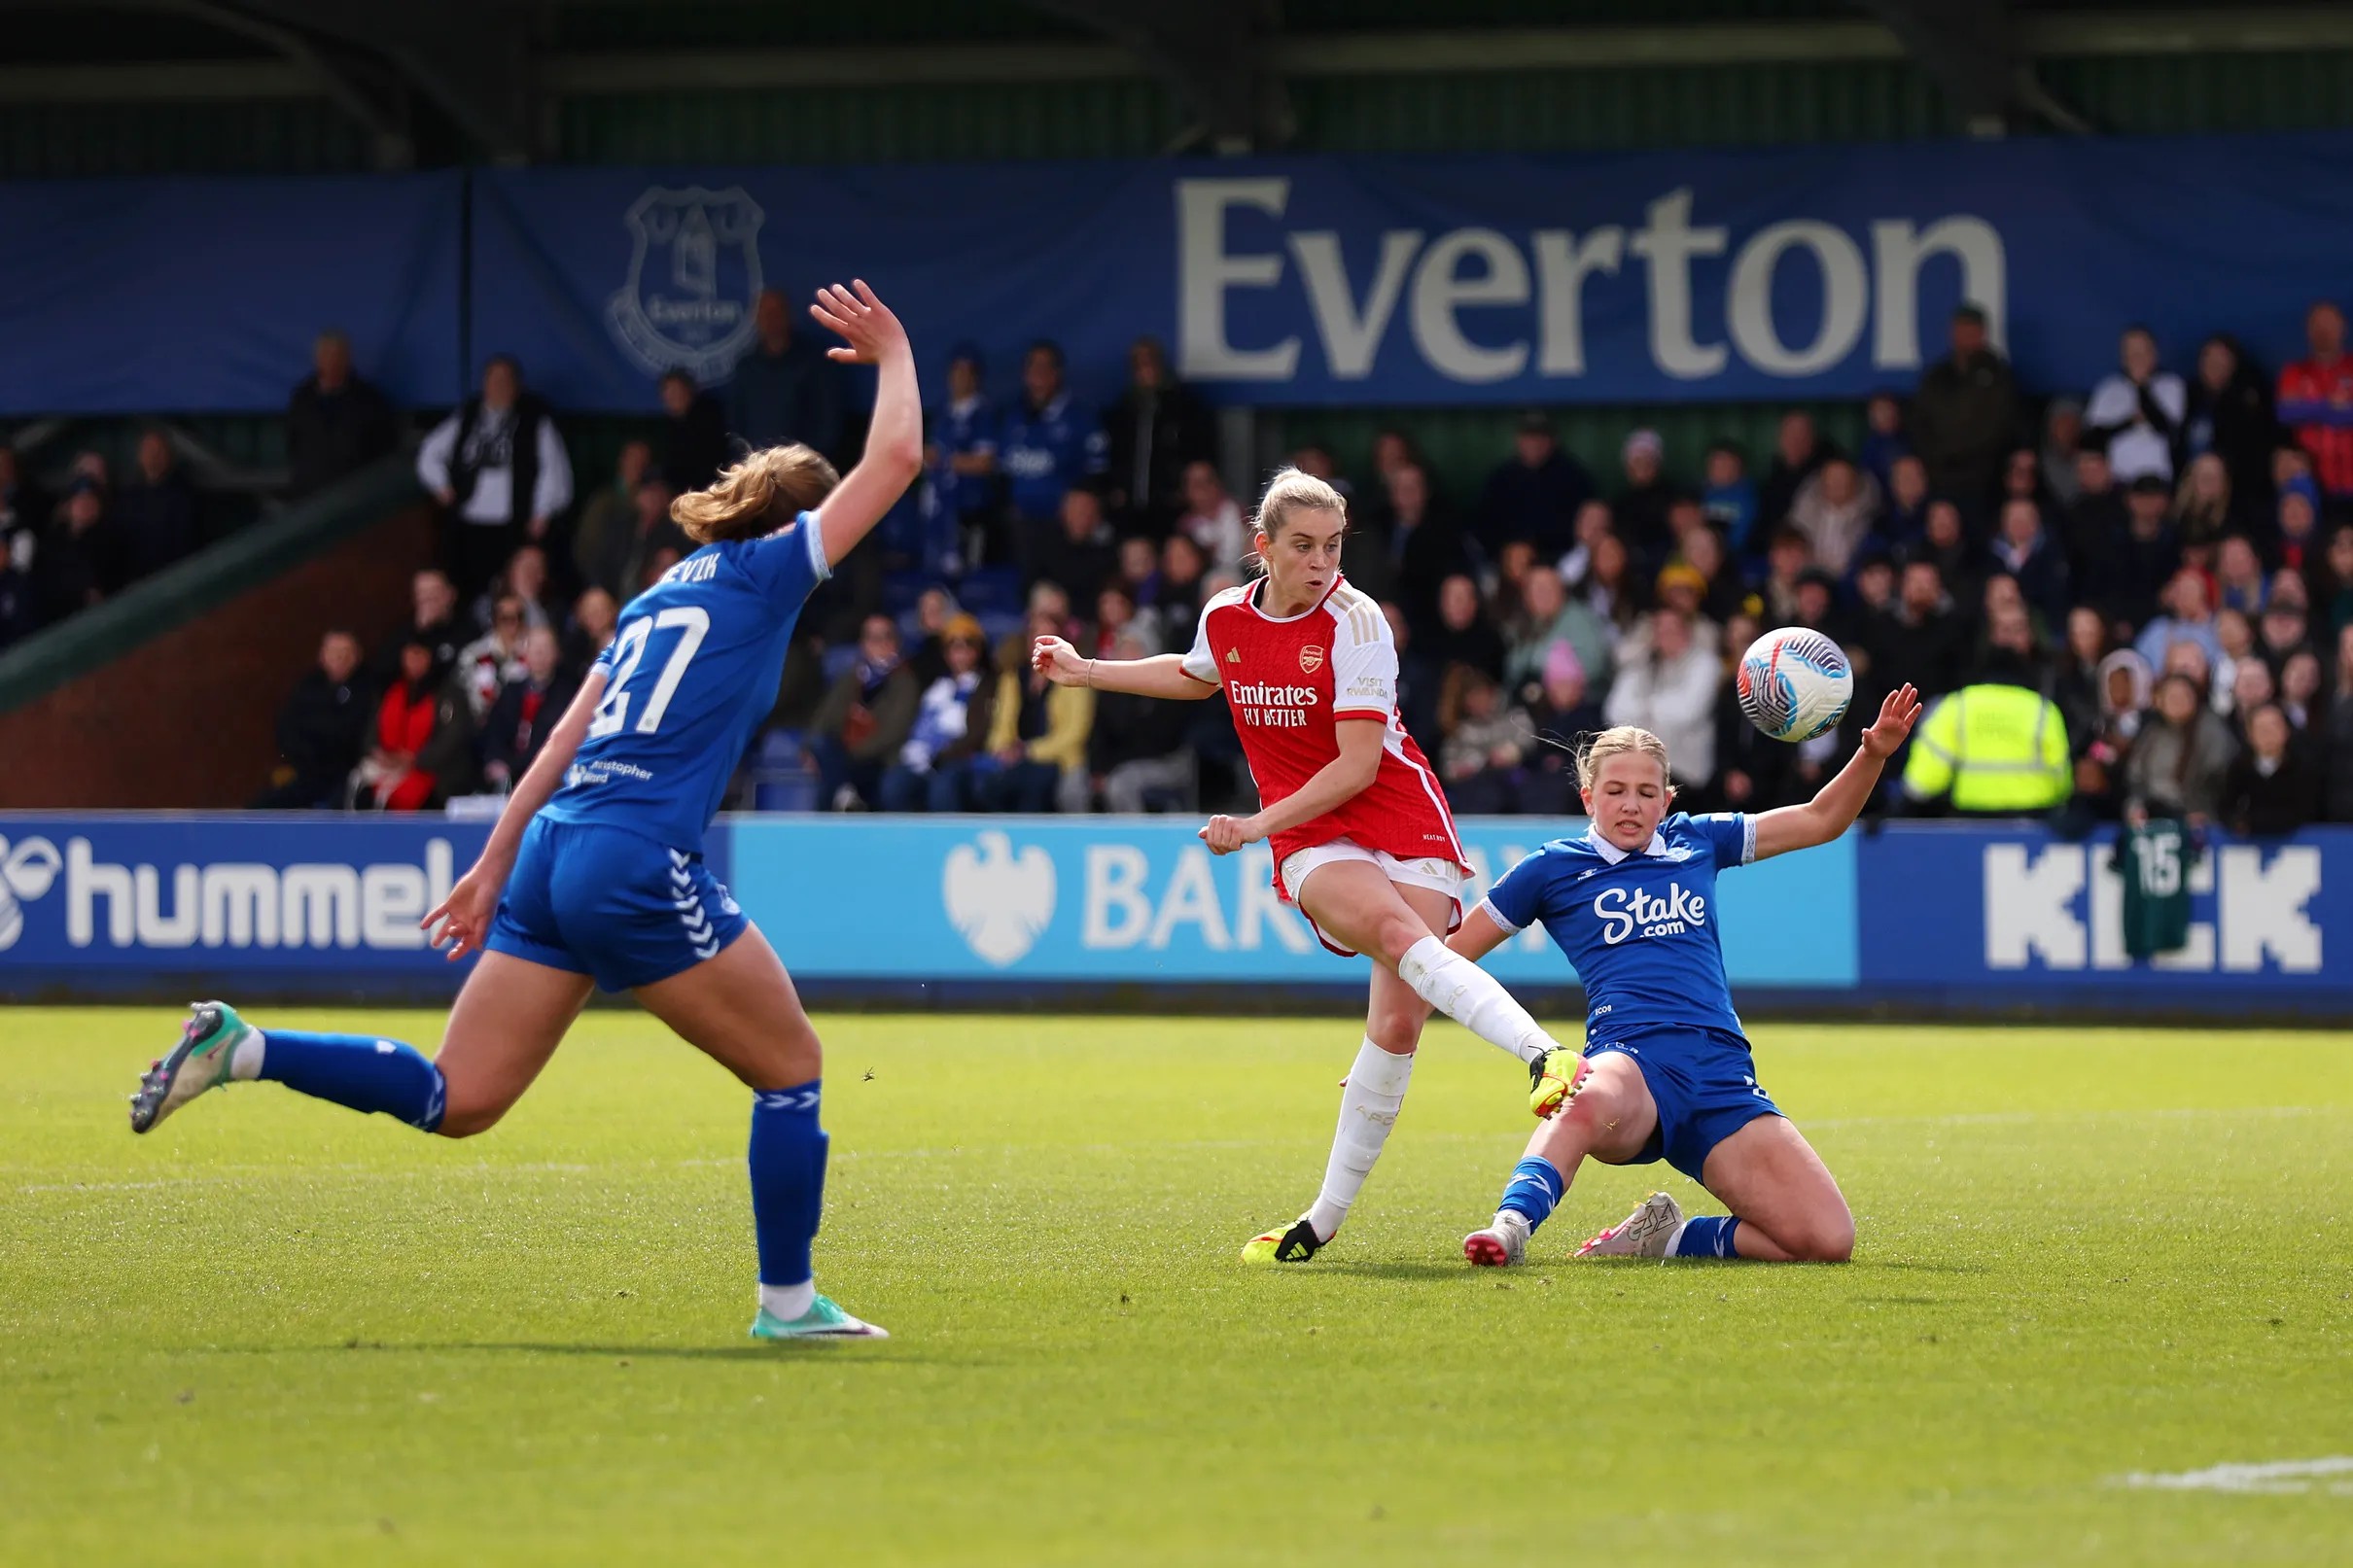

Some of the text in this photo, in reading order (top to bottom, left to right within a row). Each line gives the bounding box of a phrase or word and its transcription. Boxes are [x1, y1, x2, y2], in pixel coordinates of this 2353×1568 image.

[1175, 178, 2009, 383] Everton
[590, 606, 710, 737] 27
[1230, 680, 1317, 706] Emirates
[1347, 687, 1388, 699] RWANDA
[1358, 677, 1383, 686] VISIT
[1244, 708, 1307, 727] FLY BETTER
[2132, 832, 2182, 896] 15
[65, 835, 453, 949] hummel
[1594, 882, 1705, 945] Stake
[1639, 921, 1685, 938] .com
